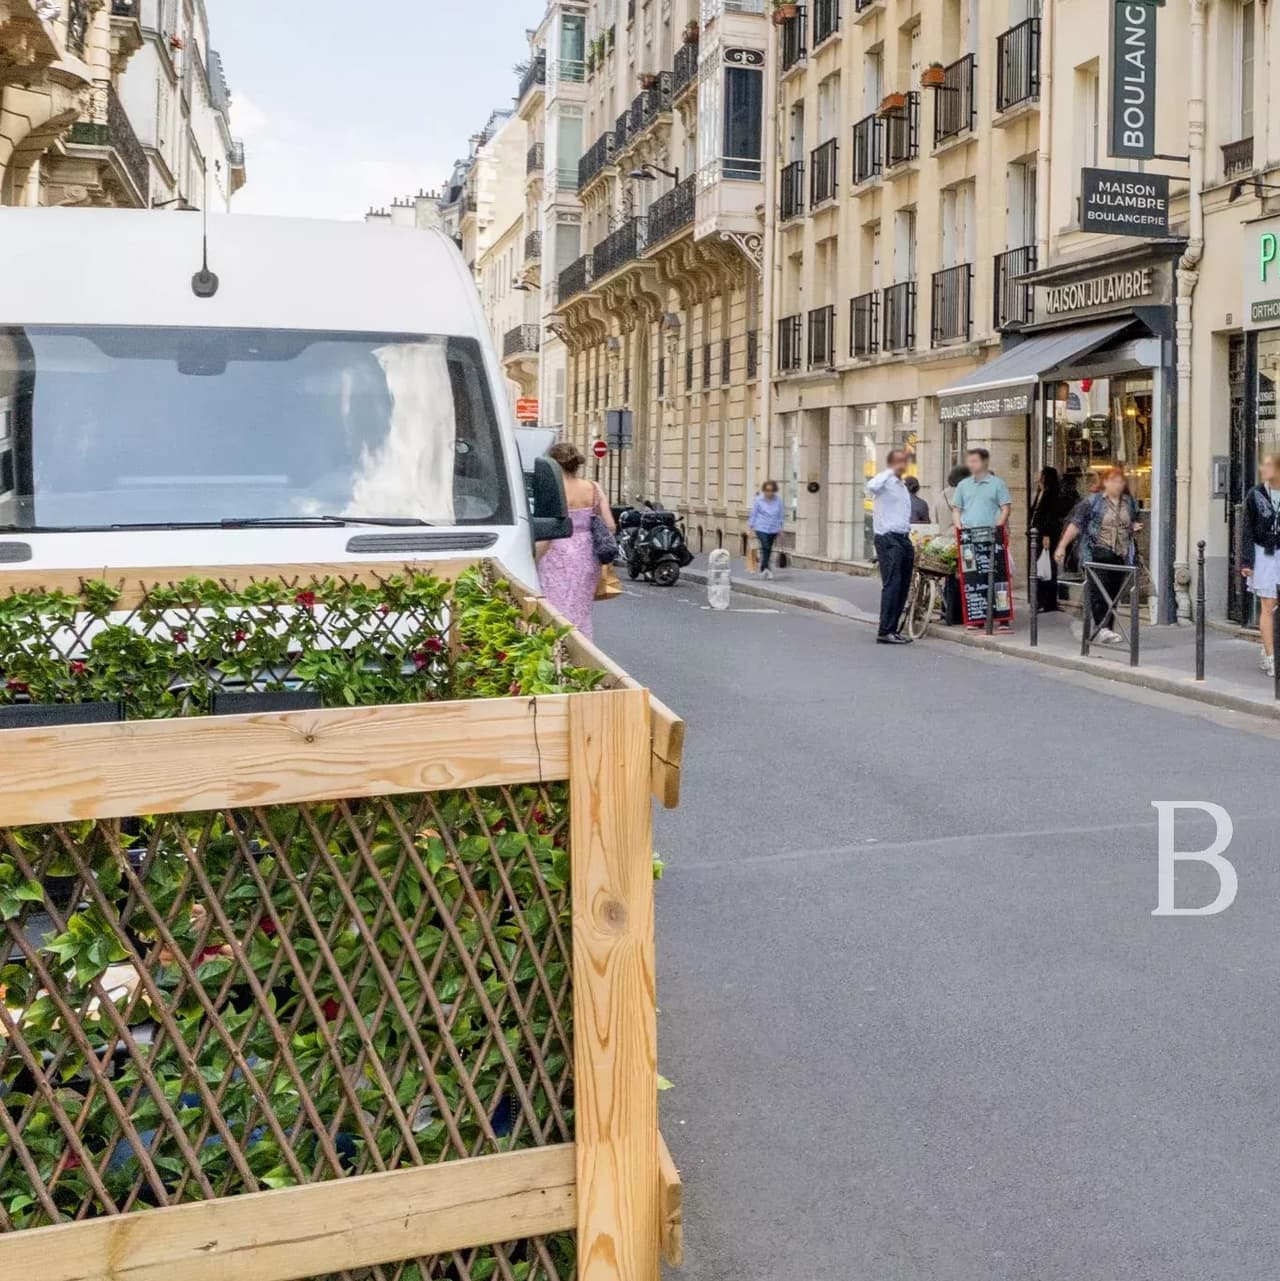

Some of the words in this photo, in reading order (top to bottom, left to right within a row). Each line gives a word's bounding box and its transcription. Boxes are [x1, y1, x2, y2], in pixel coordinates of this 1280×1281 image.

[1123, 5, 1146, 148] BOULANG
[1098, 181, 1156, 196] MAISON
[1088, 193, 1165, 210] JULAMBRE
[1087, 211, 1166, 225] BOULANGERIE
[1046, 283, 1086, 314] MAISON
[1087, 269, 1153, 306] JULAMBRE
